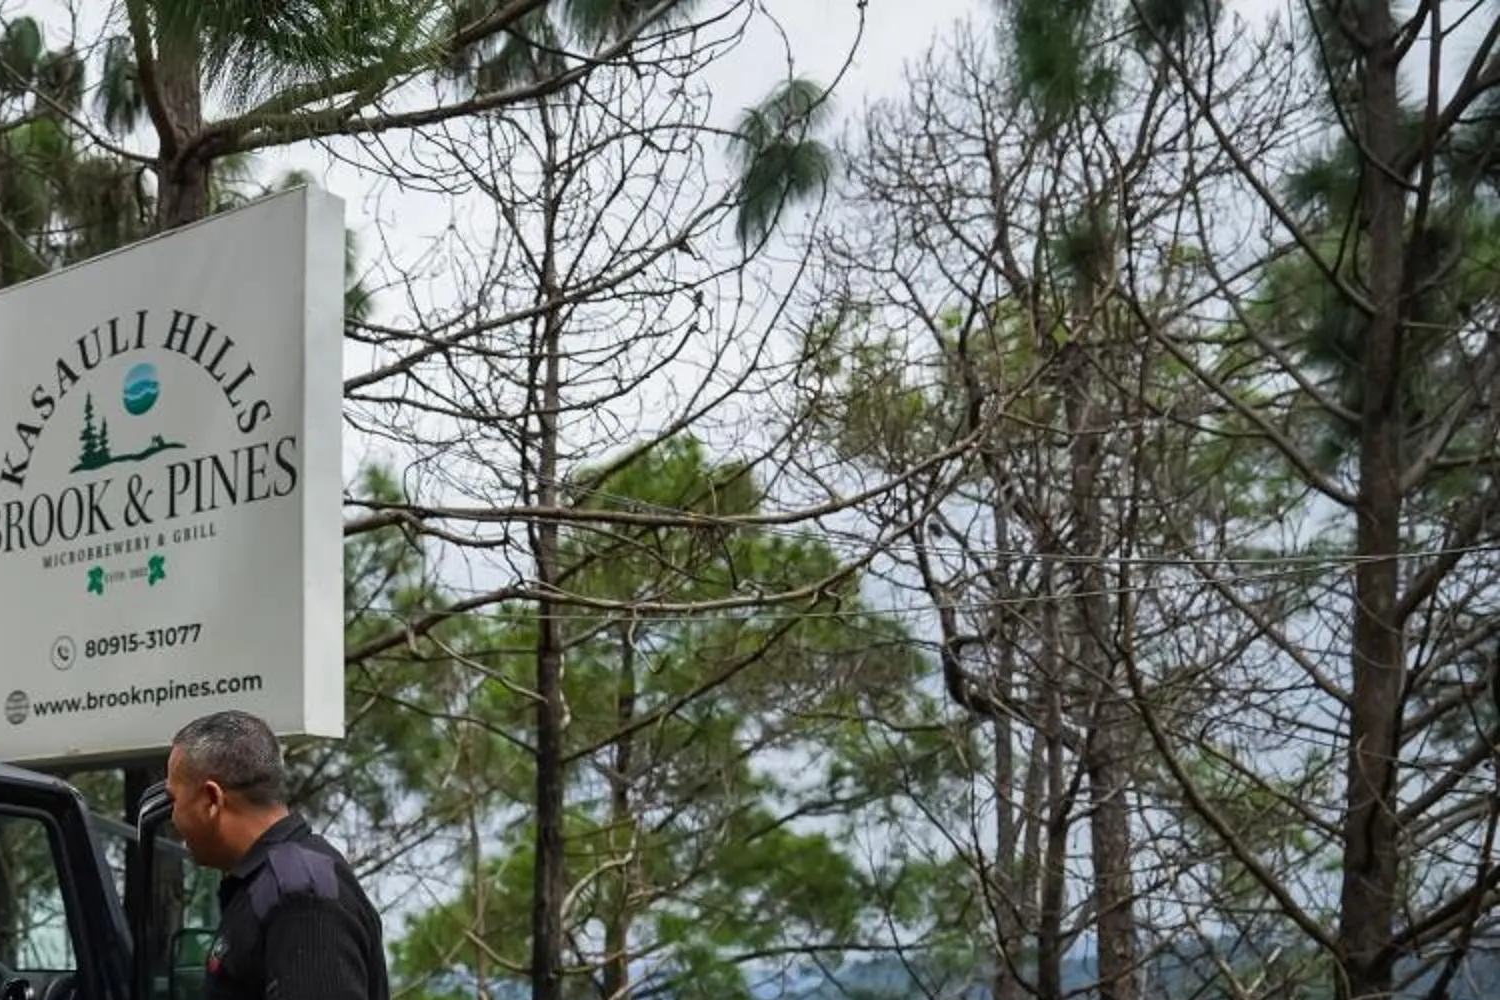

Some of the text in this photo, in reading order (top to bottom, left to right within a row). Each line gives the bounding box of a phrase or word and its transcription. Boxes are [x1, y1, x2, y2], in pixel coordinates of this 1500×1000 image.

[0, 310, 272, 488] KASAULI HILLS
[123, 473, 153, 527] &
[164, 436, 298, 520] PINES
[173, 522, 217, 544] GRILL
[84, 623, 201, 659] 80915-31077
[33, 674, 263, 717] www.brooknpines.com
